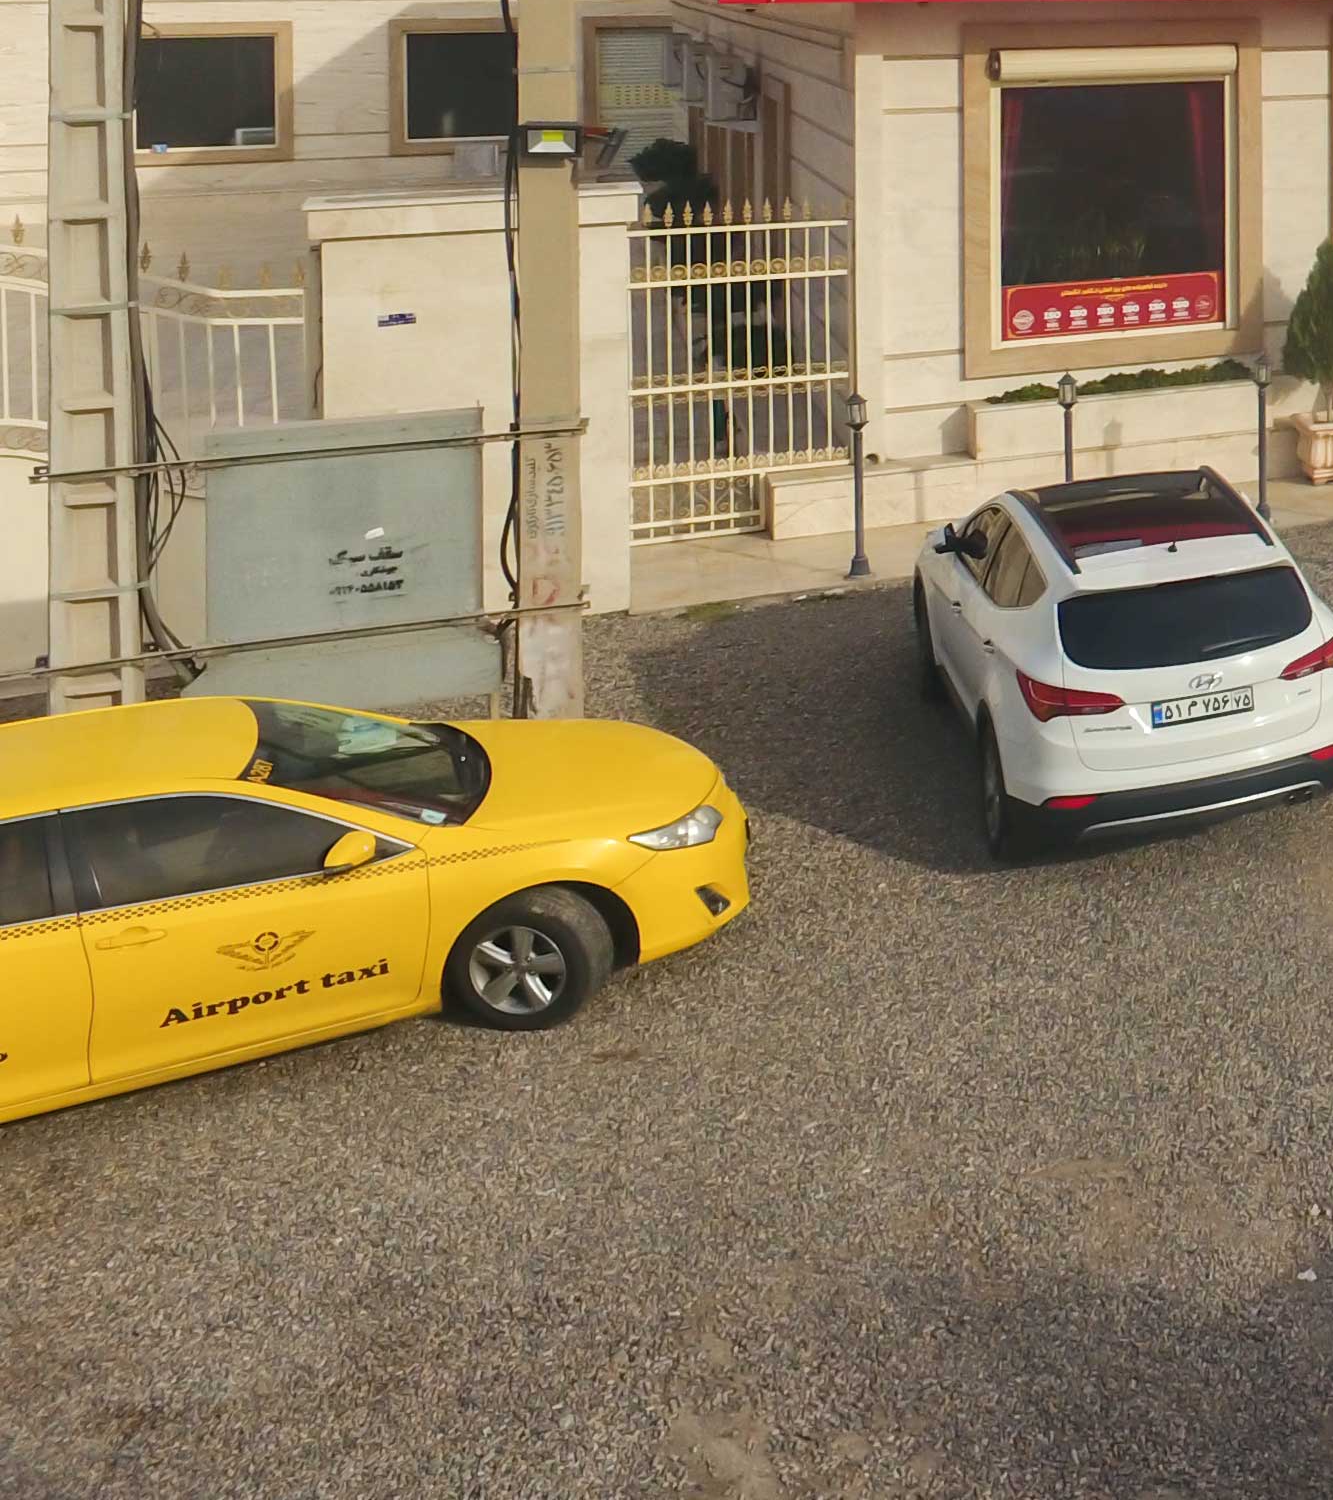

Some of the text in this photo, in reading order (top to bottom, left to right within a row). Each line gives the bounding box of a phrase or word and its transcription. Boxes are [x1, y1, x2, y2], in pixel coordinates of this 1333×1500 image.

[1164, 694, 1251, 720] ۵۱ م ۷۵۶ ۷۵
[246, 758, 274, 785] A287
[159, 958, 390, 1029] Airport taxi
